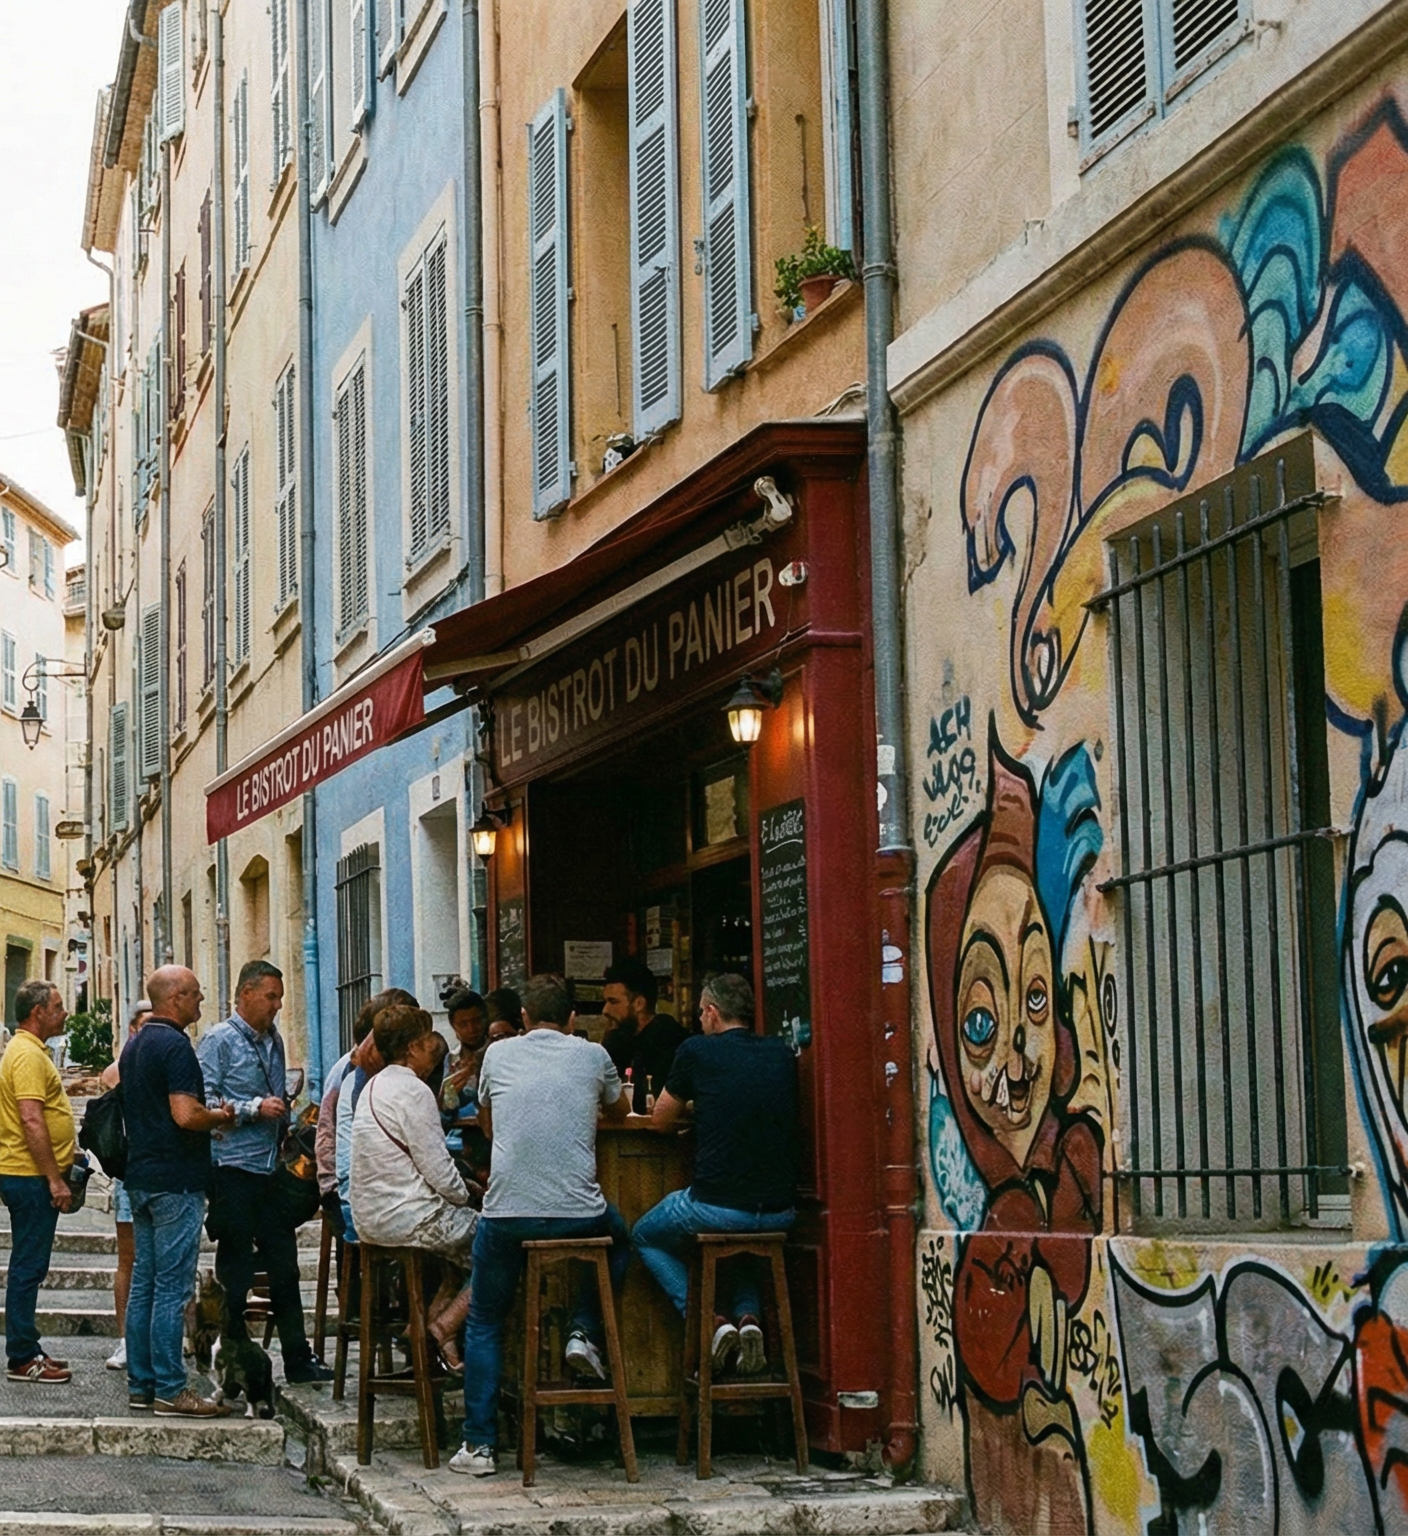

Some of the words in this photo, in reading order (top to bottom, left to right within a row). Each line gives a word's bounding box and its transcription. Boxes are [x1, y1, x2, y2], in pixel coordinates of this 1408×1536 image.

[501, 704, 523, 768] LE
[528, 647, 617, 754] BISTROT
[625, 622, 659, 703] DU
[669, 557, 776, 680] PANIER
[237, 778, 249, 821] LE
[252, 746, 300, 812] BISTROT
[302, 731, 320, 782] DU
[323, 698, 374, 770] PANIER
